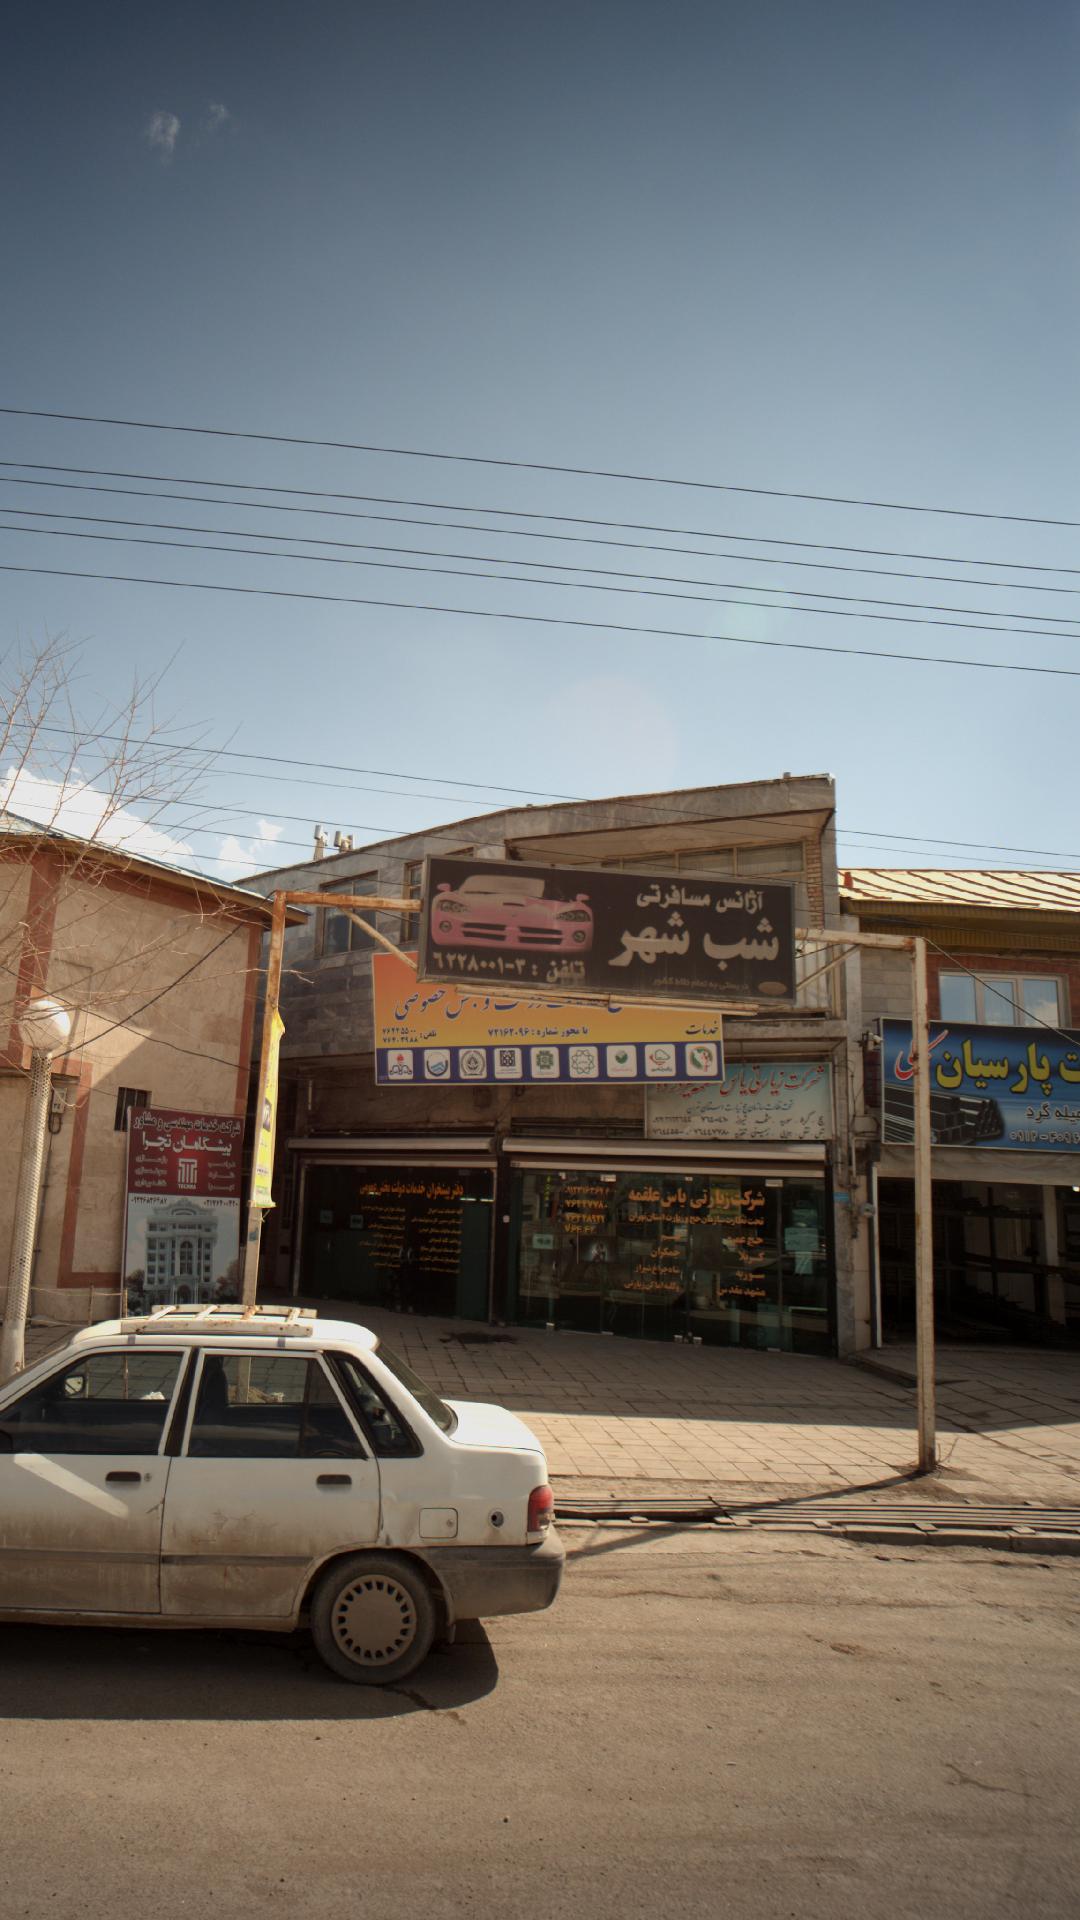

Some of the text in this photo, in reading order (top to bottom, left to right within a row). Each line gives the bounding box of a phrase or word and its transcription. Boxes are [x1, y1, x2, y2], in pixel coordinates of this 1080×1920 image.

[636, 884, 764, 914] آژانس مسافرتی
[608, 911, 780, 972] شب شهر
[546, 960, 586, 983] تلفن
[685, 1021, 718, 1035] خدمات
[935, 1039, 1052, 1096] پارسیان
[164, 1117, 193, 1132] مهندسی
[195, 1118, 217, 1132] خدمات
[661, 1187, 688, 1209] یاس
[690, 1187, 731, 1210] زیارتی
[732, 1189, 766, 1211] شرکت
